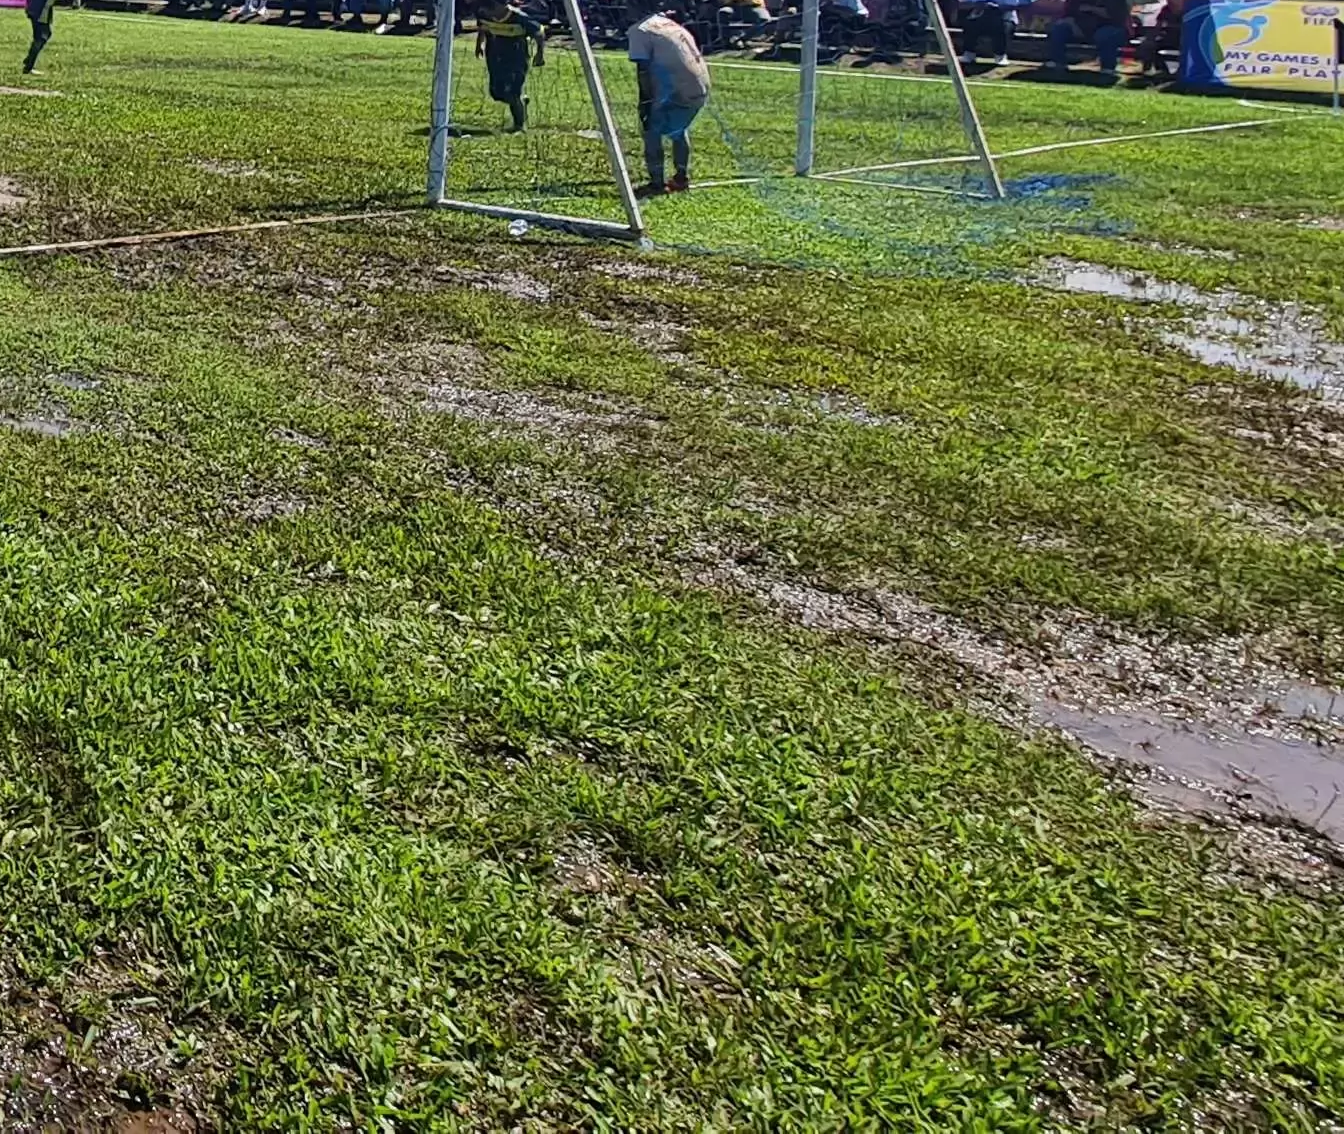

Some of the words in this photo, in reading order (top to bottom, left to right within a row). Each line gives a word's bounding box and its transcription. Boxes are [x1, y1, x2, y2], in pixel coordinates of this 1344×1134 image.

[1224, 50, 1251, 61] MY
[1256, 52, 1320, 66] GAMES
[1223, 63, 1272, 75] FAIR
